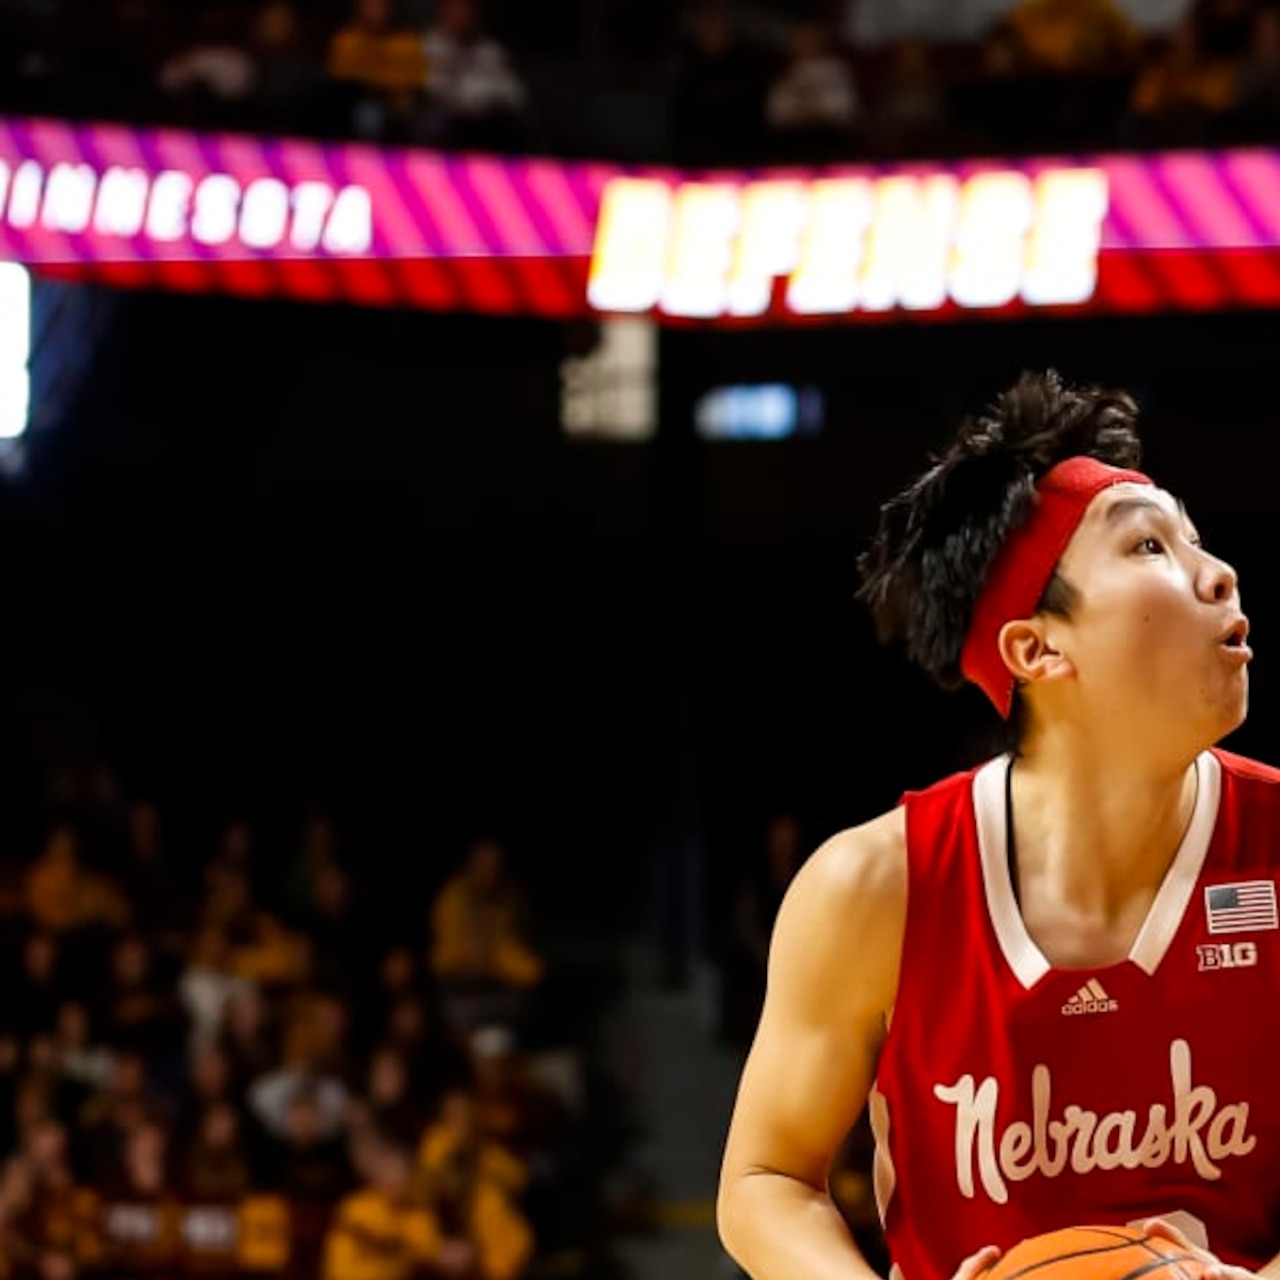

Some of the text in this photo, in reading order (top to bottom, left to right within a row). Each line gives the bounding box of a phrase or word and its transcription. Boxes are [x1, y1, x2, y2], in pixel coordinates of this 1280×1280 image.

[0, 157, 373, 255] INNESOTA
[1061, 999, 1119, 1016] adidas
[934, 1038, 1257, 1205] Nebraska
